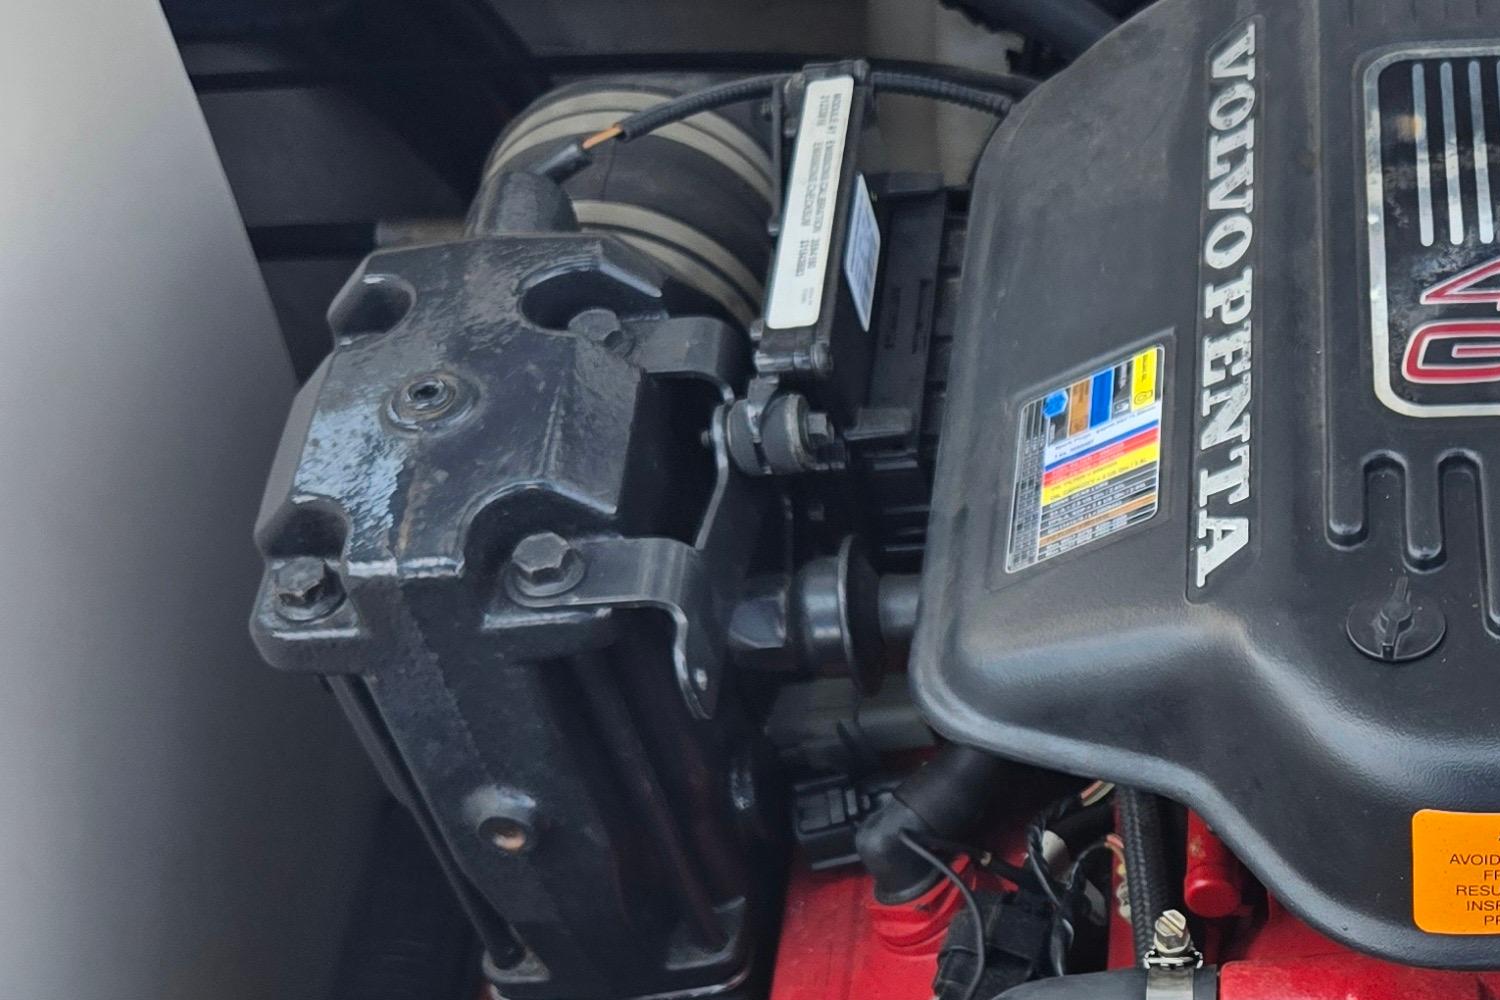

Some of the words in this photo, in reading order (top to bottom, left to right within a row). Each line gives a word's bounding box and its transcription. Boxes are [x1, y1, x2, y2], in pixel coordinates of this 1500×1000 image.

[1205, 23, 1256, 270] VOLVO
[1196, 271, 1253, 588] PENTA
[1449, 853, 1500, 866] AVOID
